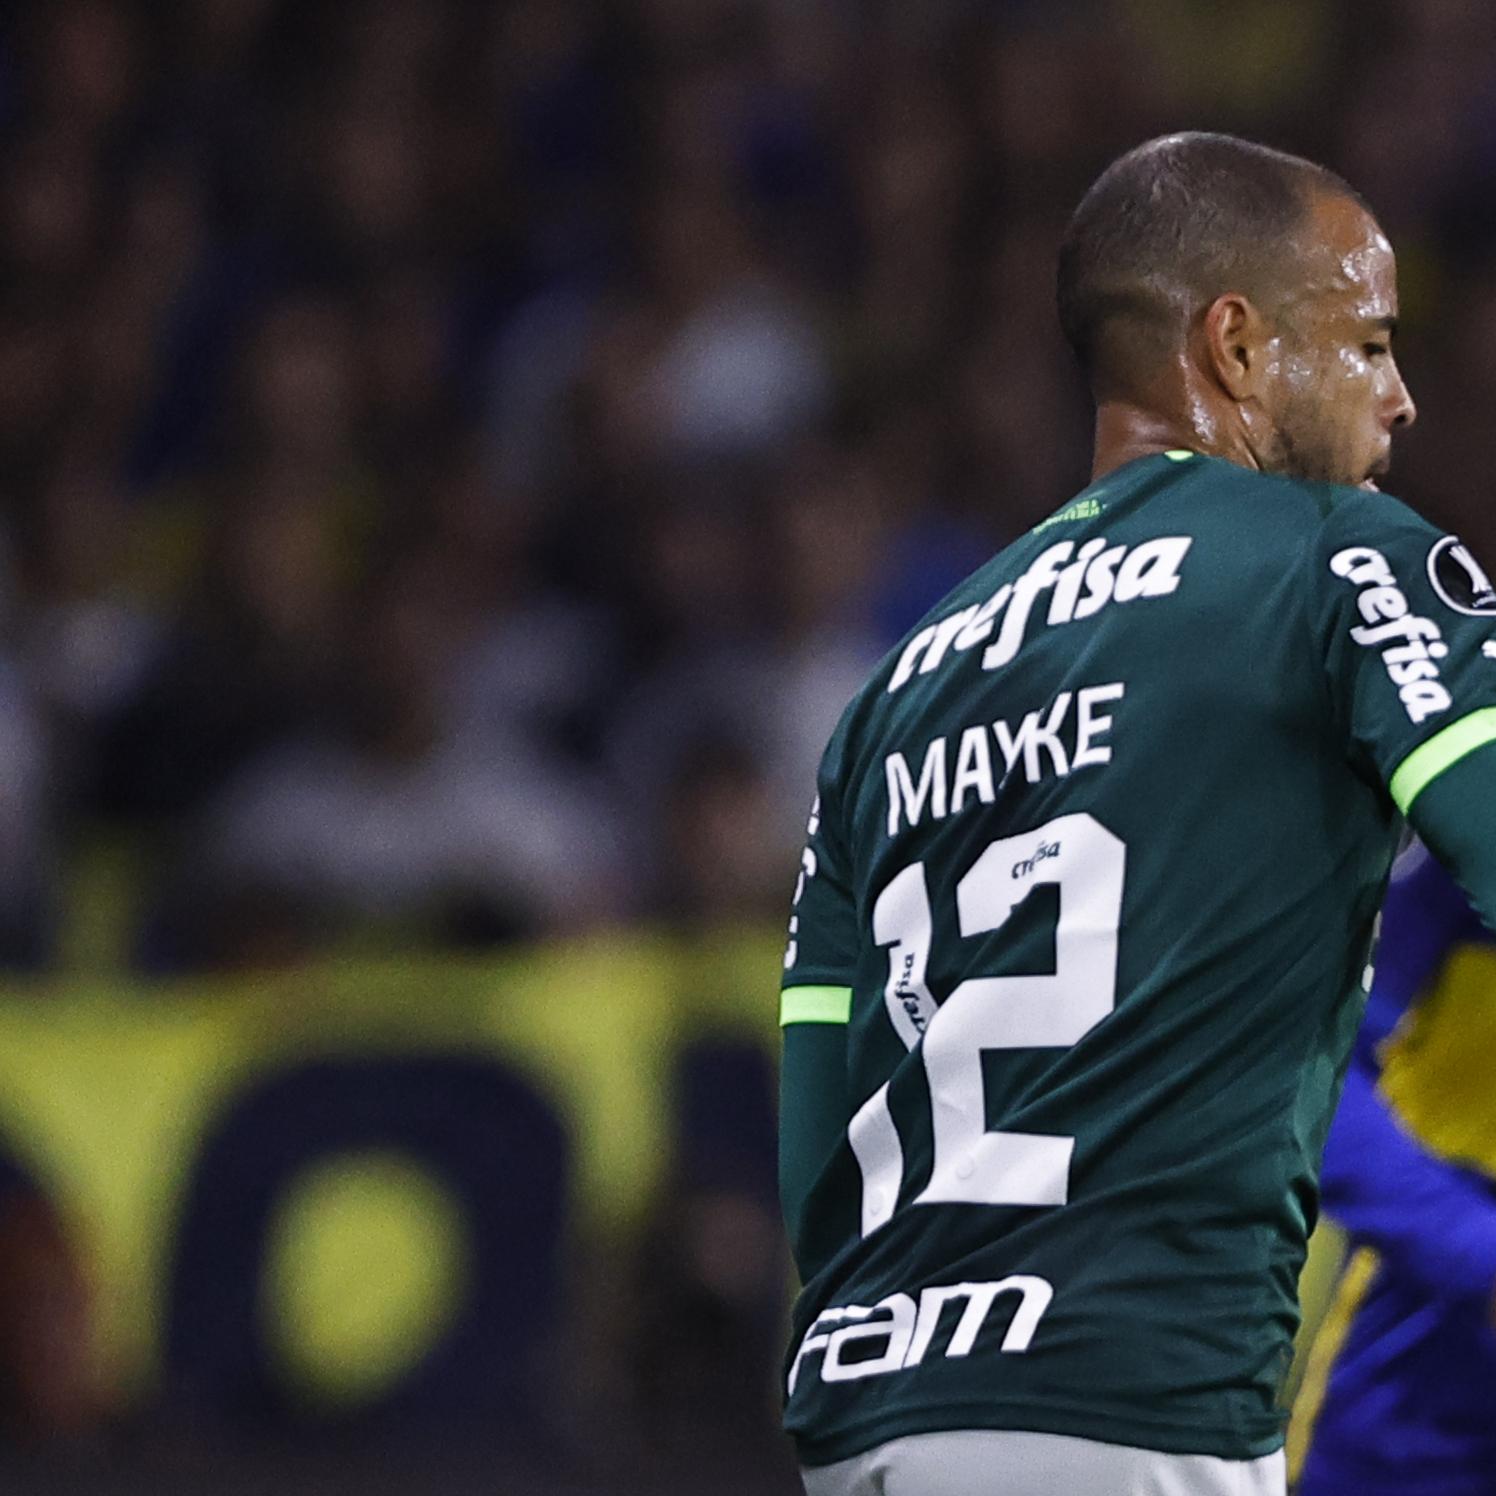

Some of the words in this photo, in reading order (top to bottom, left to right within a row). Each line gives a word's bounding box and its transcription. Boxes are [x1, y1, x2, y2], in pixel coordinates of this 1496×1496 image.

[888, 536, 1192, 693] crefisa
[1330, 547, 1452, 724] crefisa
[885, 682, 1125, 838] MAYKE
[848, 811, 1127, 1238] 12
